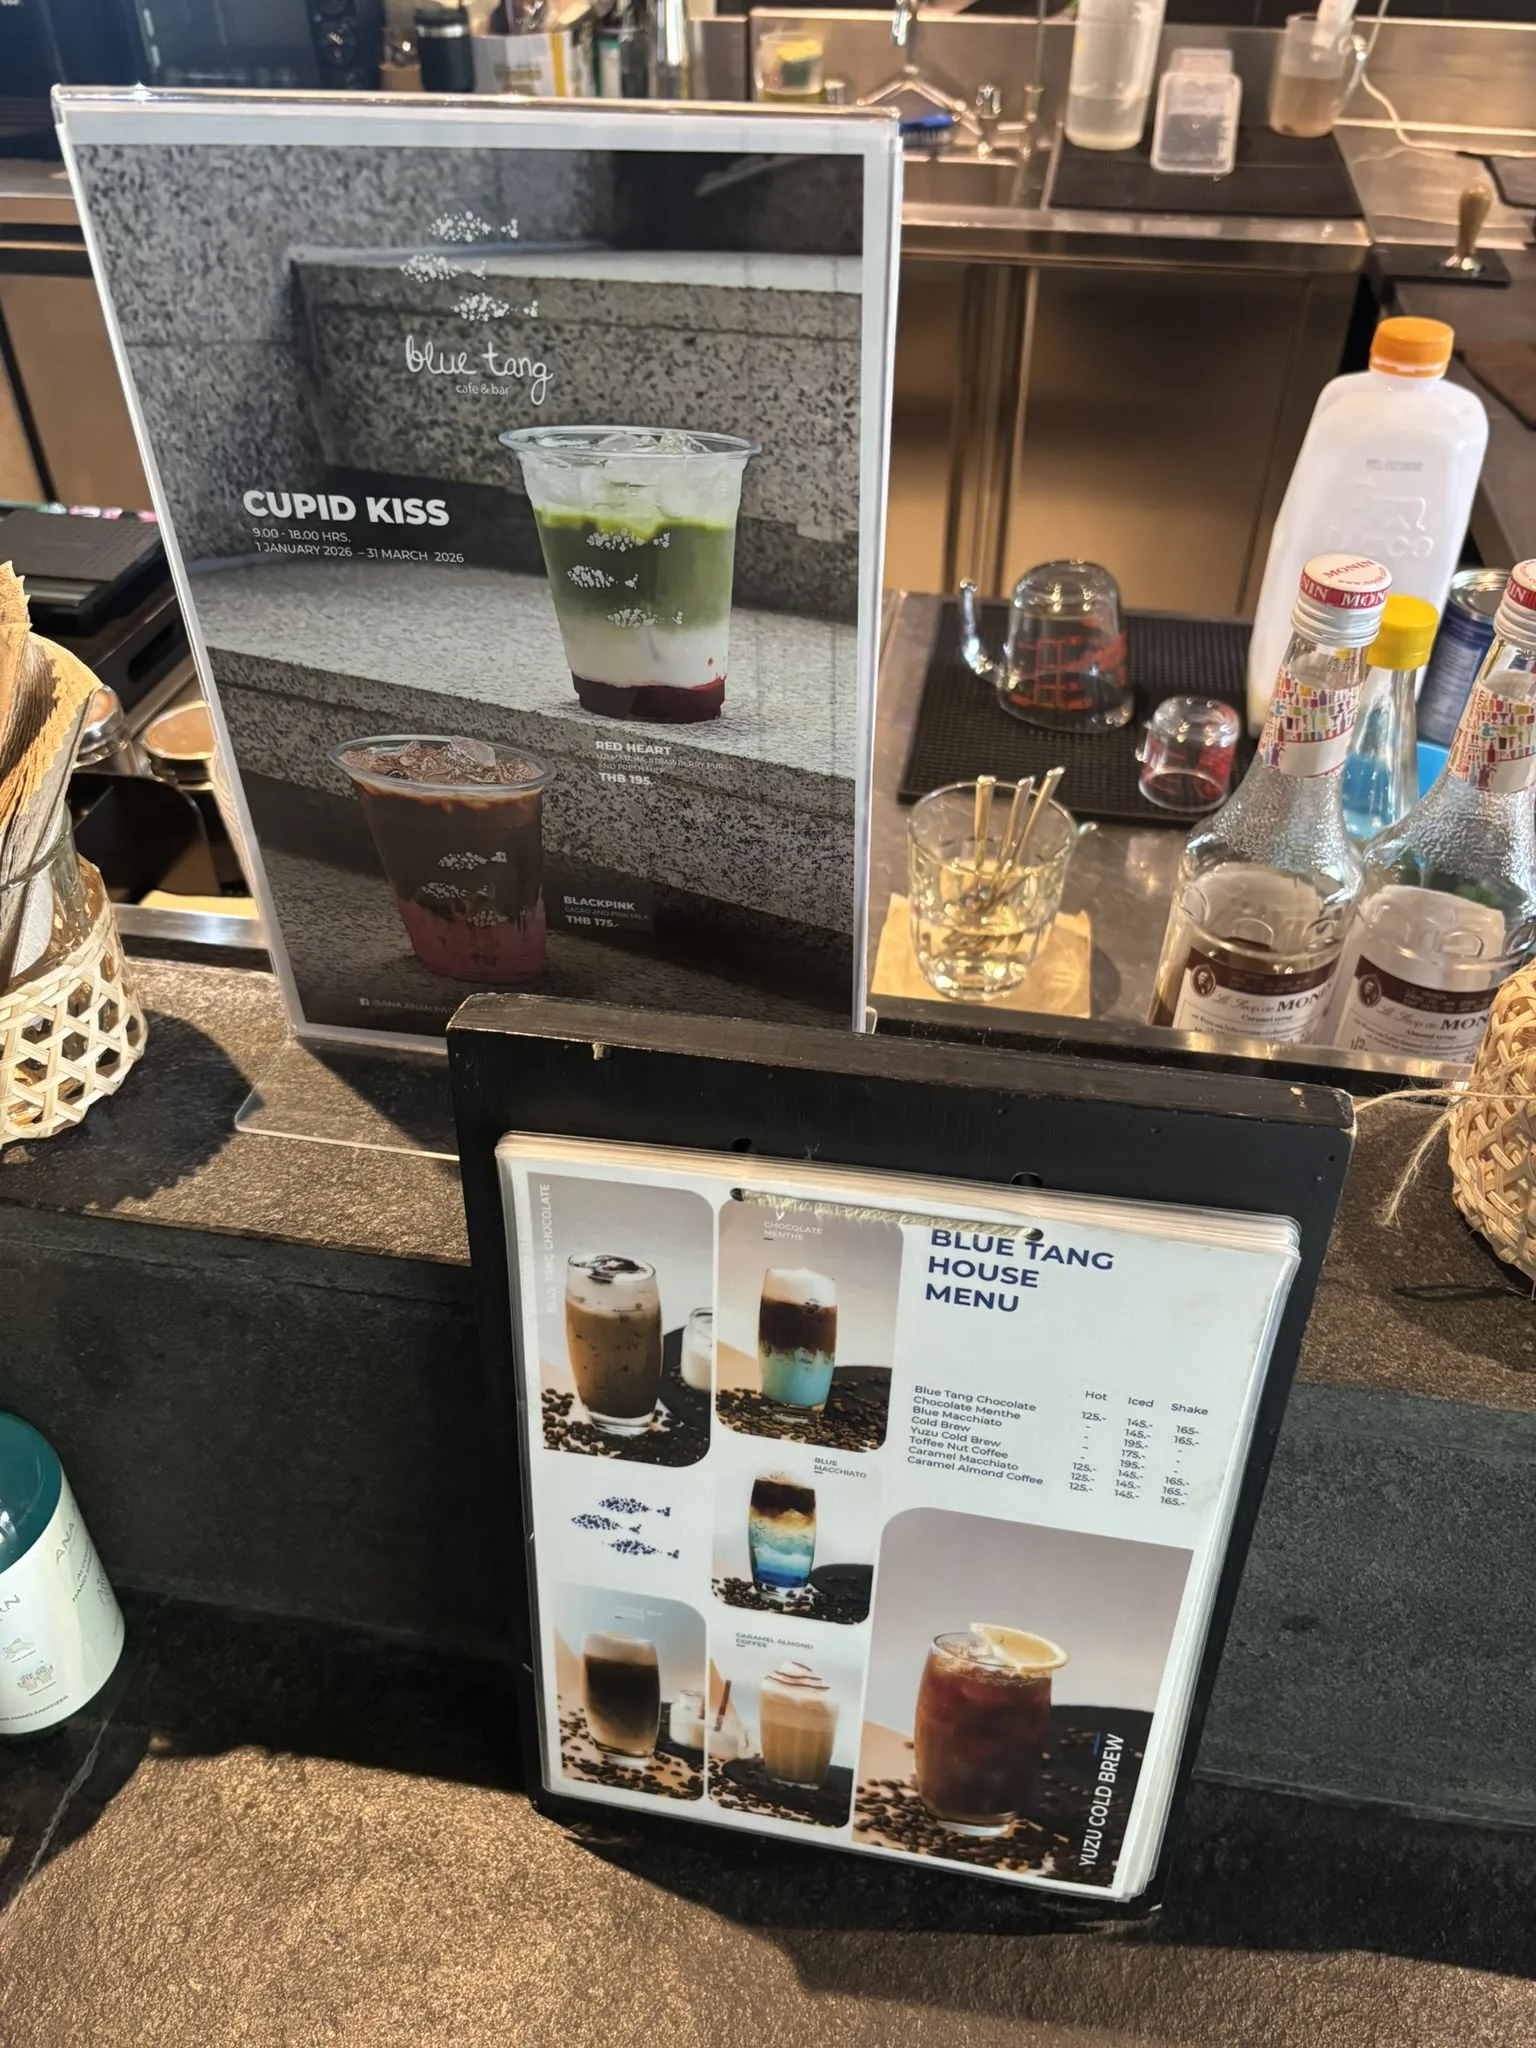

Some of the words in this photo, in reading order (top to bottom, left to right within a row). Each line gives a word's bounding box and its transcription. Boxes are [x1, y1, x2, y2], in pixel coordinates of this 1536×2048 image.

[406, 334, 478, 375] blue
[482, 341, 554, 406] tang
[456, 382, 479, 395] cafe
[481, 384, 490, 394] &
[491, 384, 510, 395] bar
[243, 490, 357, 522] CUPID
[365, 496, 450, 527] KISS
[252, 527, 279, 539] 9.00
[288, 529, 320, 541] 18.00
[322, 531, 352, 543] HRS.
[256, 542, 261, 552] 1
[263, 542, 321, 556] JANUARY
[324, 546, 353, 557] 2026
[366, 548, 378, 559] 31
[381, 549, 428, 561] MARCH
[434, 552, 464, 564] 2026
[1322, 560, 1376, 578] MONIN
[595, 740, 623, 751] RED
[626, 743, 672, 756] HEART
[599, 772, 627, 784] THB
[629, 773, 657, 786] 195.-
[563, 895, 635, 911] BLACKPINK
[566, 915, 592, 925] THB
[594, 918, 620, 928] 175.-
[540, 1183, 554, 1250] CHOCOLATE
[763, 1221, 823, 1235] CHOCOLATE
[763, 1230, 804, 1241] MENTHE
[931, 1228, 1015, 1257] BLUE
[1024, 1241, 1115, 1271] TANG
[928, 1255, 1040, 1288] HOUSE
[925, 1282, 1019, 1313] MENU
[914, 1385, 942, 1396] Blue
[944, 1389, 974, 1403] Tang
[976, 1395, 1036, 1412] Chocolate
[1081, 1411, 1107, 1422] 125.-
[1127, 1418, 1154, 1429] 145.-
[1085, 1390, 1107, 1401] Hot
[1128, 1397, 1154, 1408] Iced
[1171, 1403, 1209, 1416] Shake
[912, 1405, 939, 1417] Blue
[941, 1410, 1003, 1427] Macchiato
[1124, 1439, 1149, 1449] 195.-
[913, 1395, 973, 1412] Chocolate
[975, 1406, 1021, 1420] Menthe
[1125, 1428, 1151, 1439] 145.-
[1174, 1435, 1200, 1446] 165.-
[910, 1425, 939, 1437] Yuzu
[941, 1431, 968, 1442] Cold
[970, 1435, 1001, 1448] Brew
[1120, 1459, 1145, 1469] 195.-
[911, 1416, 938, 1427] Cold
[940, 1420, 971, 1432] Brew
[1121, 1449, 1146, 1459] 175.-
[814, 1457, 838, 1466] BLUE
[814, 1465, 867, 1478] MACCHIATO
[908, 1446, 956, 1460] Caramel
[959, 1454, 1019, 1471] Macchiato
[1071, 1472, 1095, 1482] 125.-
[1115, 1479, 1140, 1489] 145.-
[1162, 1486, 1188, 1497] 165.-
[909, 1435, 944, 1448] Toffee
[946, 1442, 969, 1453] Nut
[971, 1446, 1009, 1459] Coffee
[1072, 1462, 1097, 1473] 125.-
[1118, 1469, 1143, 1479] 145.-
[1165, 1476, 1190, 1486] 165.-
[907, 1455, 955, 1470] Caramel
[957, 1463, 1004, 1479] Almond
[1006, 1472, 1044, 1485] Coffee
[1069, 1482, 1093, 1492] 125.-
[1114, 1489, 1139, 1499] 145.-
[1160, 1496, 1185, 1506] 165.-
[736, 1632, 775, 1644] CARAMEL
[777, 1639, 814, 1649] ALMOND
[736, 1639, 767, 1648] COFFEE
[1097, 1733, 1124, 1783] BREW
[1089, 1785, 1113, 1826] COLD
[1079, 1829, 1103, 1866] YUZU
